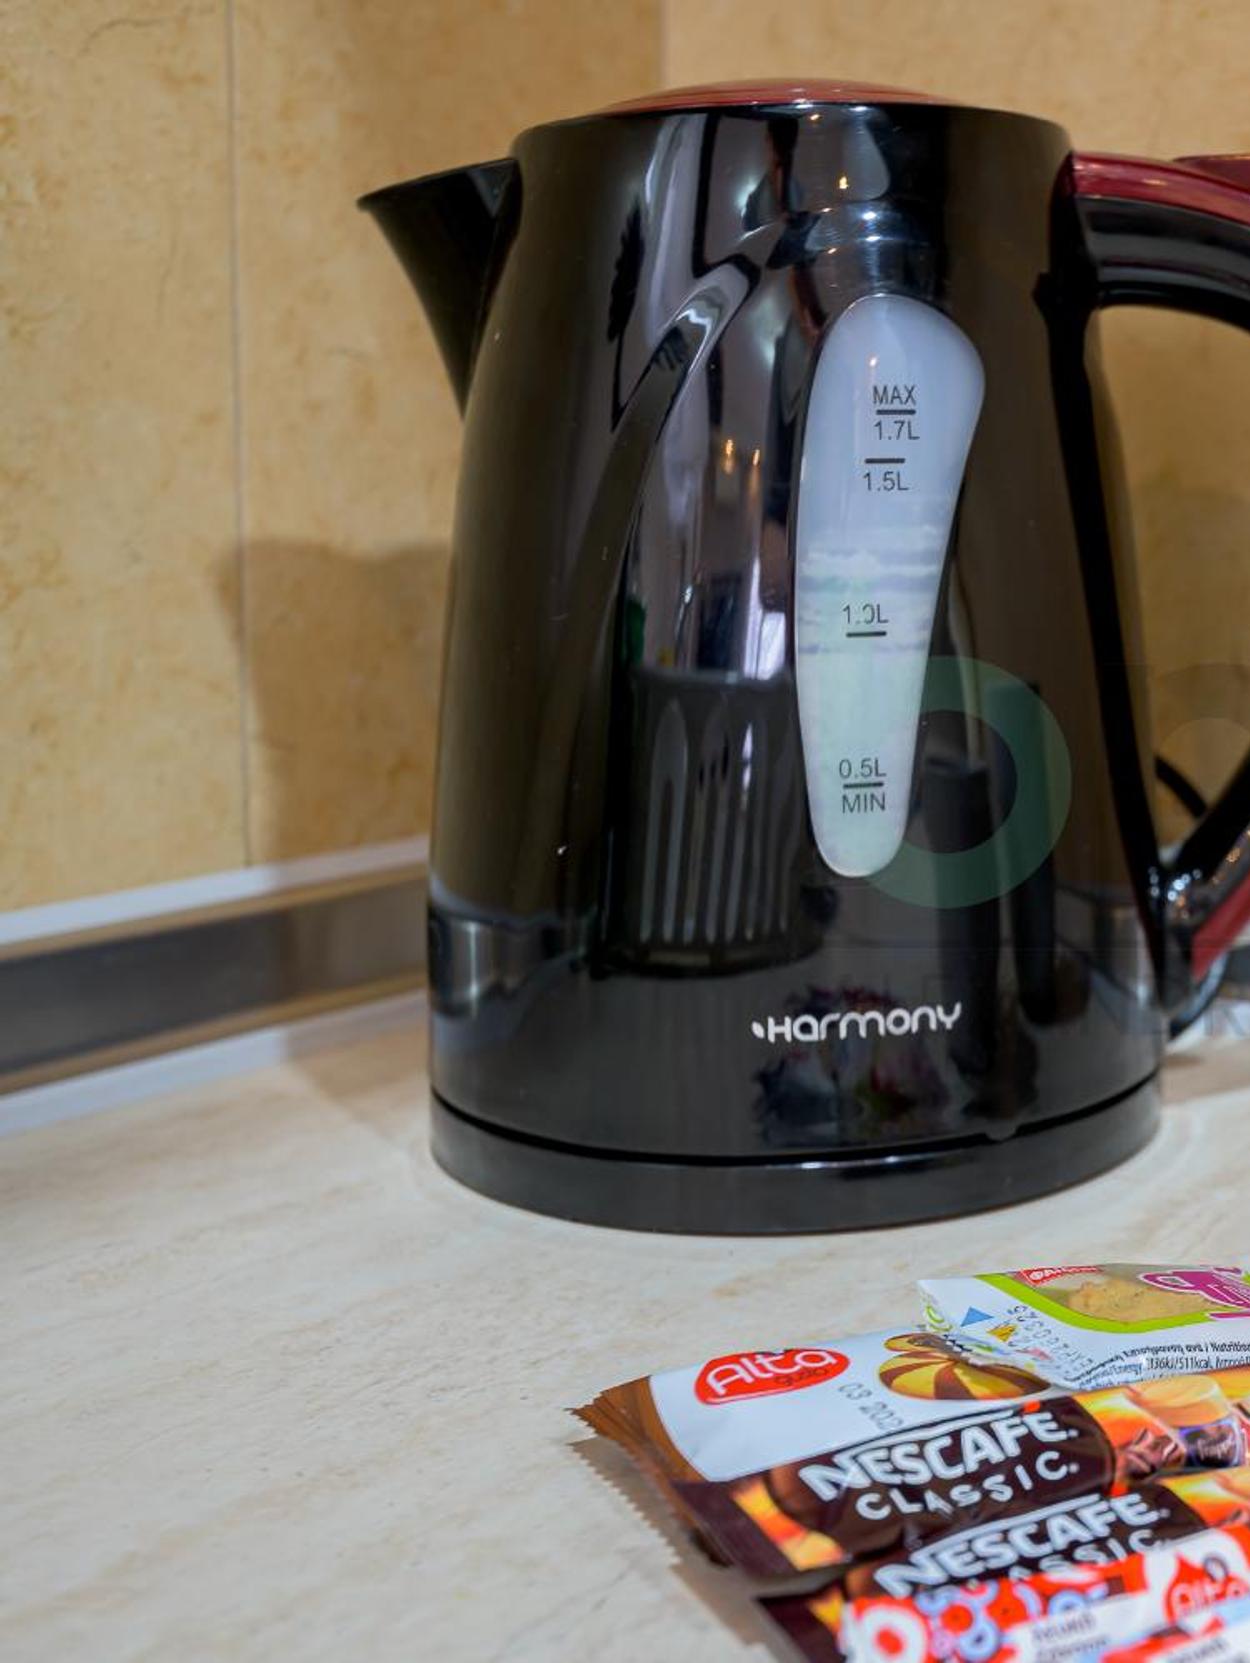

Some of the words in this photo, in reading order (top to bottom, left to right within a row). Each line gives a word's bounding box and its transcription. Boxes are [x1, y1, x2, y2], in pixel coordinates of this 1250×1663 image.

[872, 385, 916, 405] MAX
[874, 420, 920, 441] 1.7L
[862, 472, 909, 493] 1.5L
[842, 604, 889, 625] 1.0L
[838, 758, 887, 778] 0.5L
[841, 793, 886, 814] MIN
[705, 1349, 838, 1396] Alta
[855, 1450, 1068, 1520] CLASSIC
[1008, 1529, 1158, 1581] ASSIC
